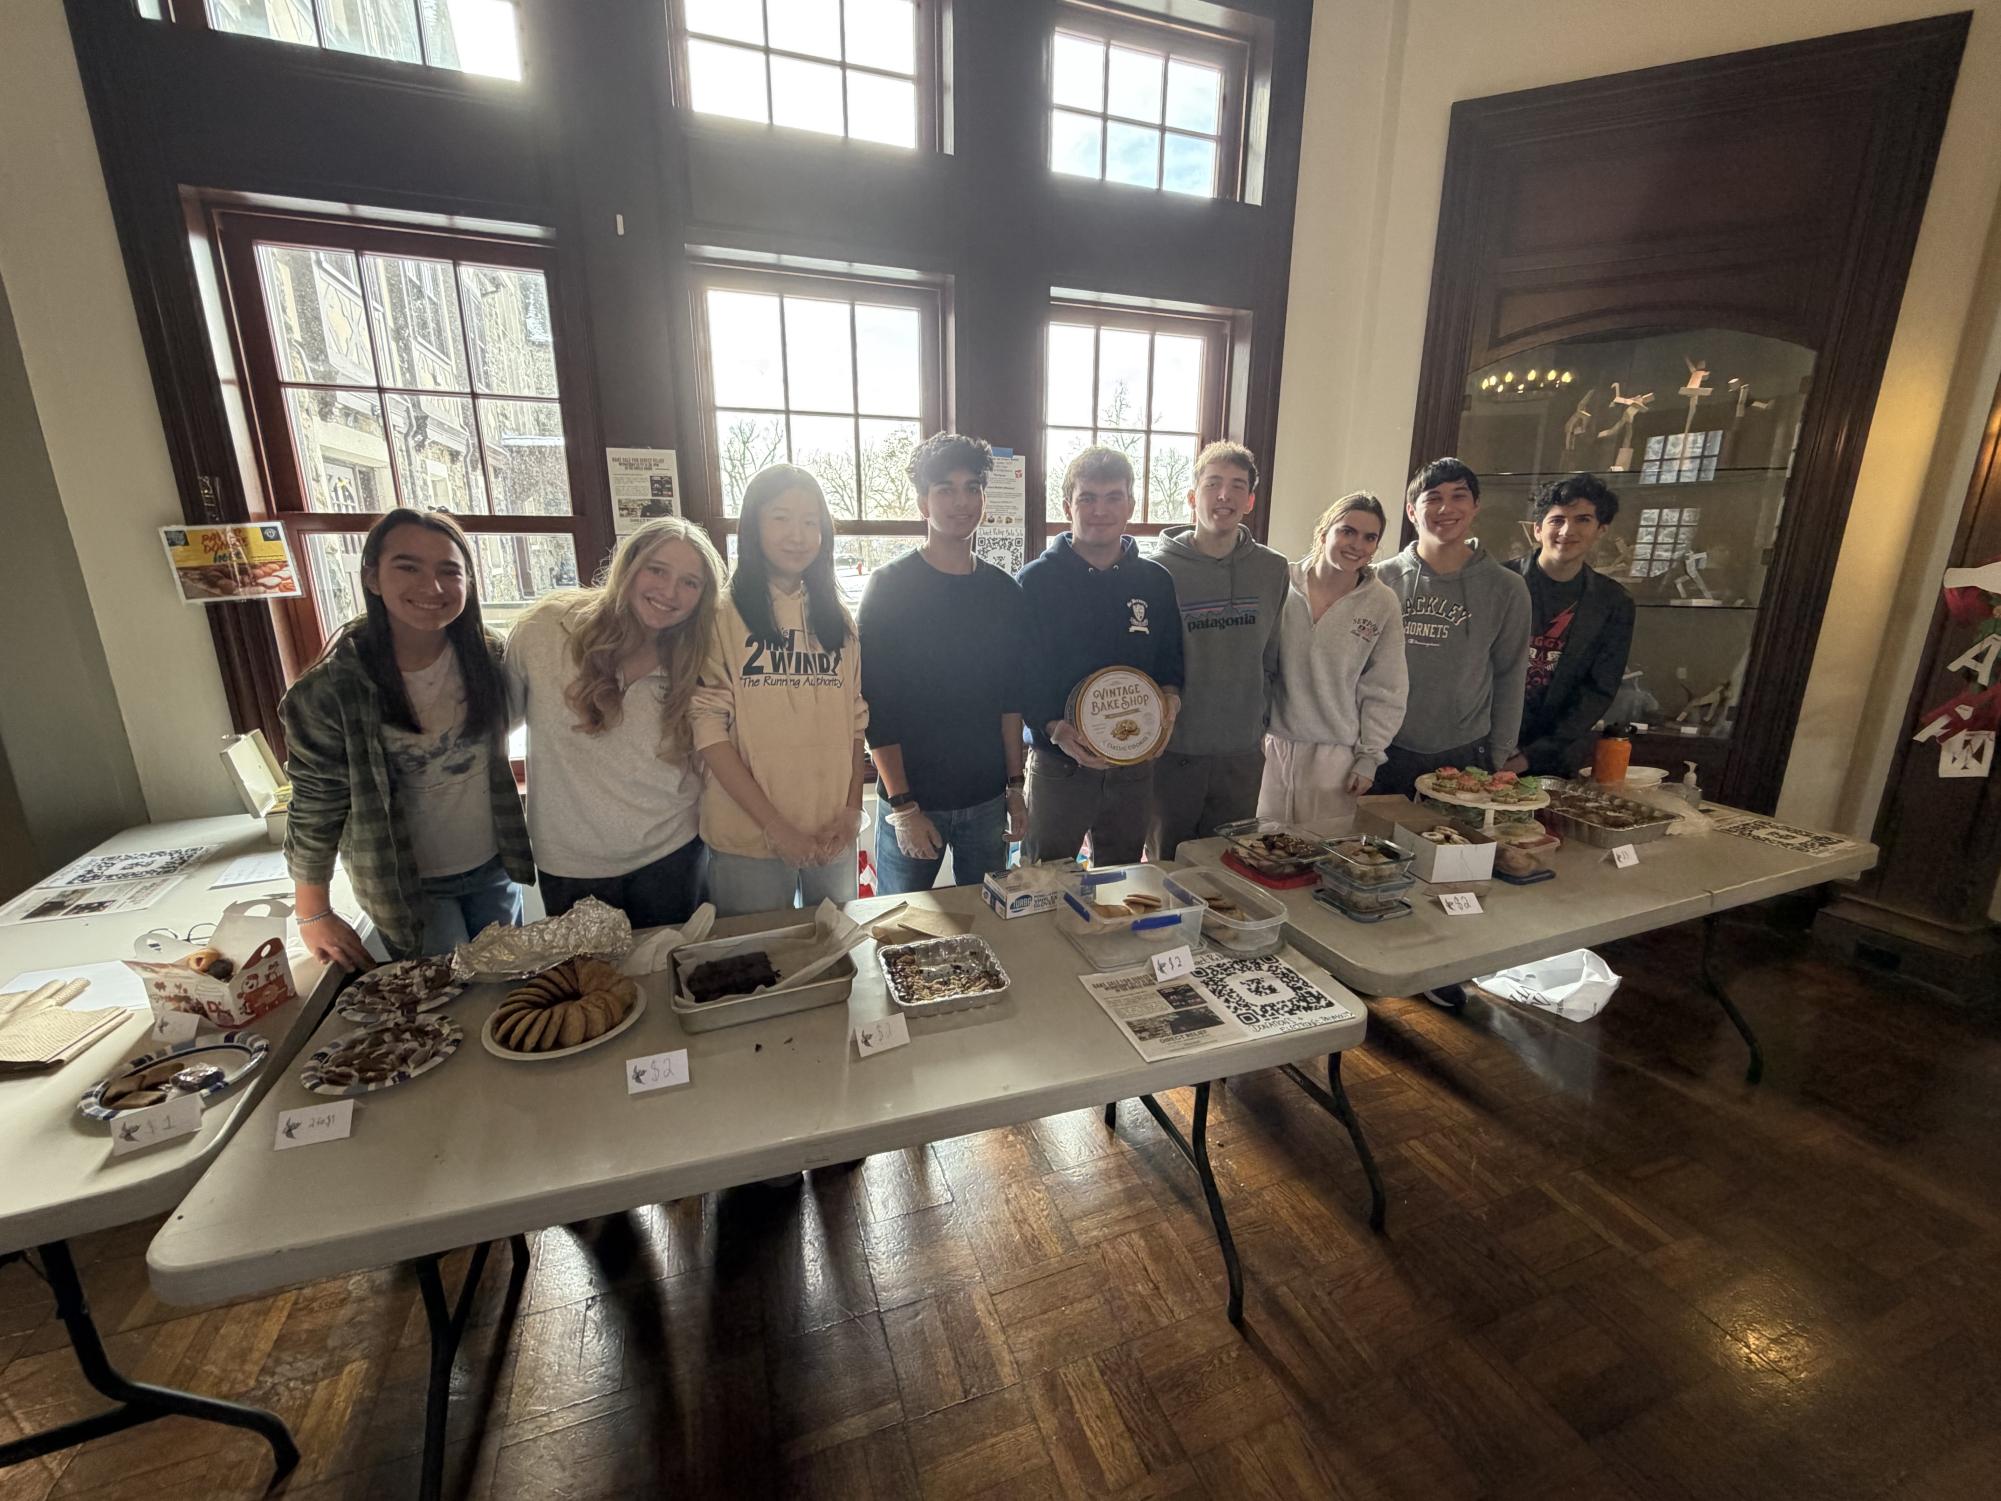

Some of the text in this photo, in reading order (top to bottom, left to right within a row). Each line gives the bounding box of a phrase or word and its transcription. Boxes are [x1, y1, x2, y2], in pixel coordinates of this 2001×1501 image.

[1402, 596, 1473, 626] ACKLEY
[1187, 613, 1257, 632] patagonia
[741, 676, 760, 688] The
[763, 675, 802, 688] Running
